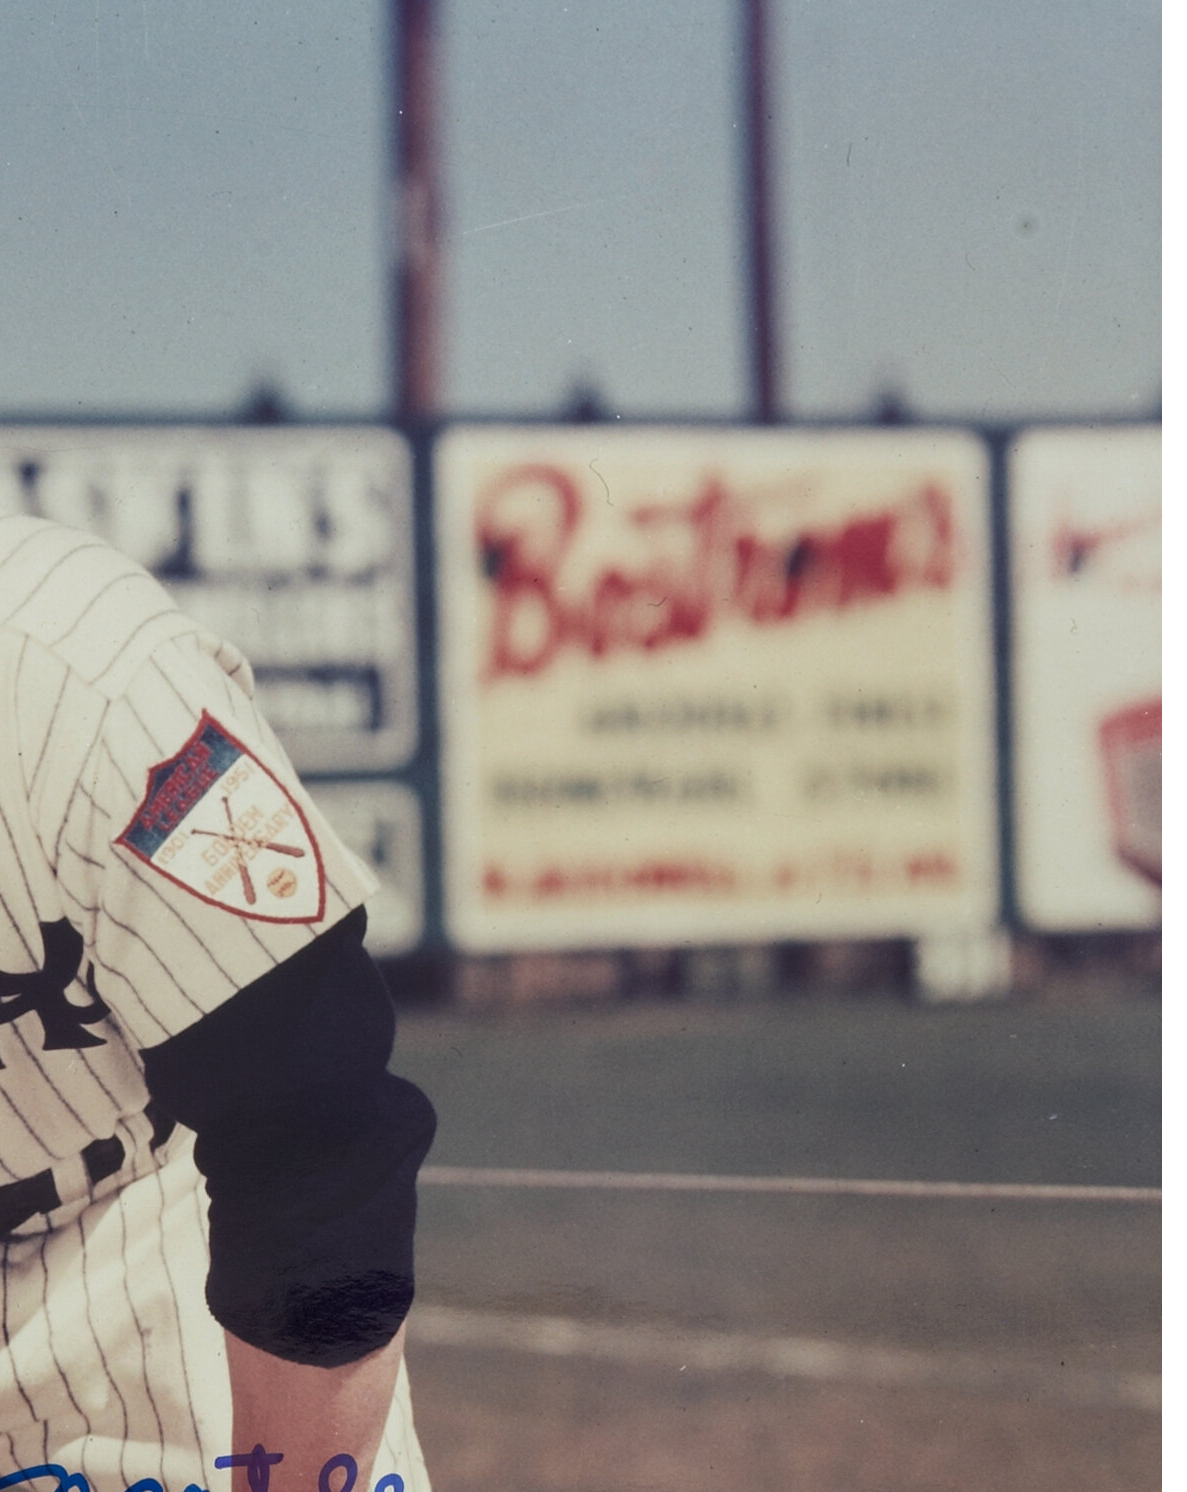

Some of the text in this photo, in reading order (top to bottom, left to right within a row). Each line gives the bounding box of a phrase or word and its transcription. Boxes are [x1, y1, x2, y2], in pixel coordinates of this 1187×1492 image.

[141, 741, 212, 830] AMERICAN
[159, 760, 256, 866] 1901 1951
[160, 767, 220, 832] LEAGUE
[201, 804, 266, 866] GOLDEN
[204, 803, 296, 895] ANNIVERSARY
